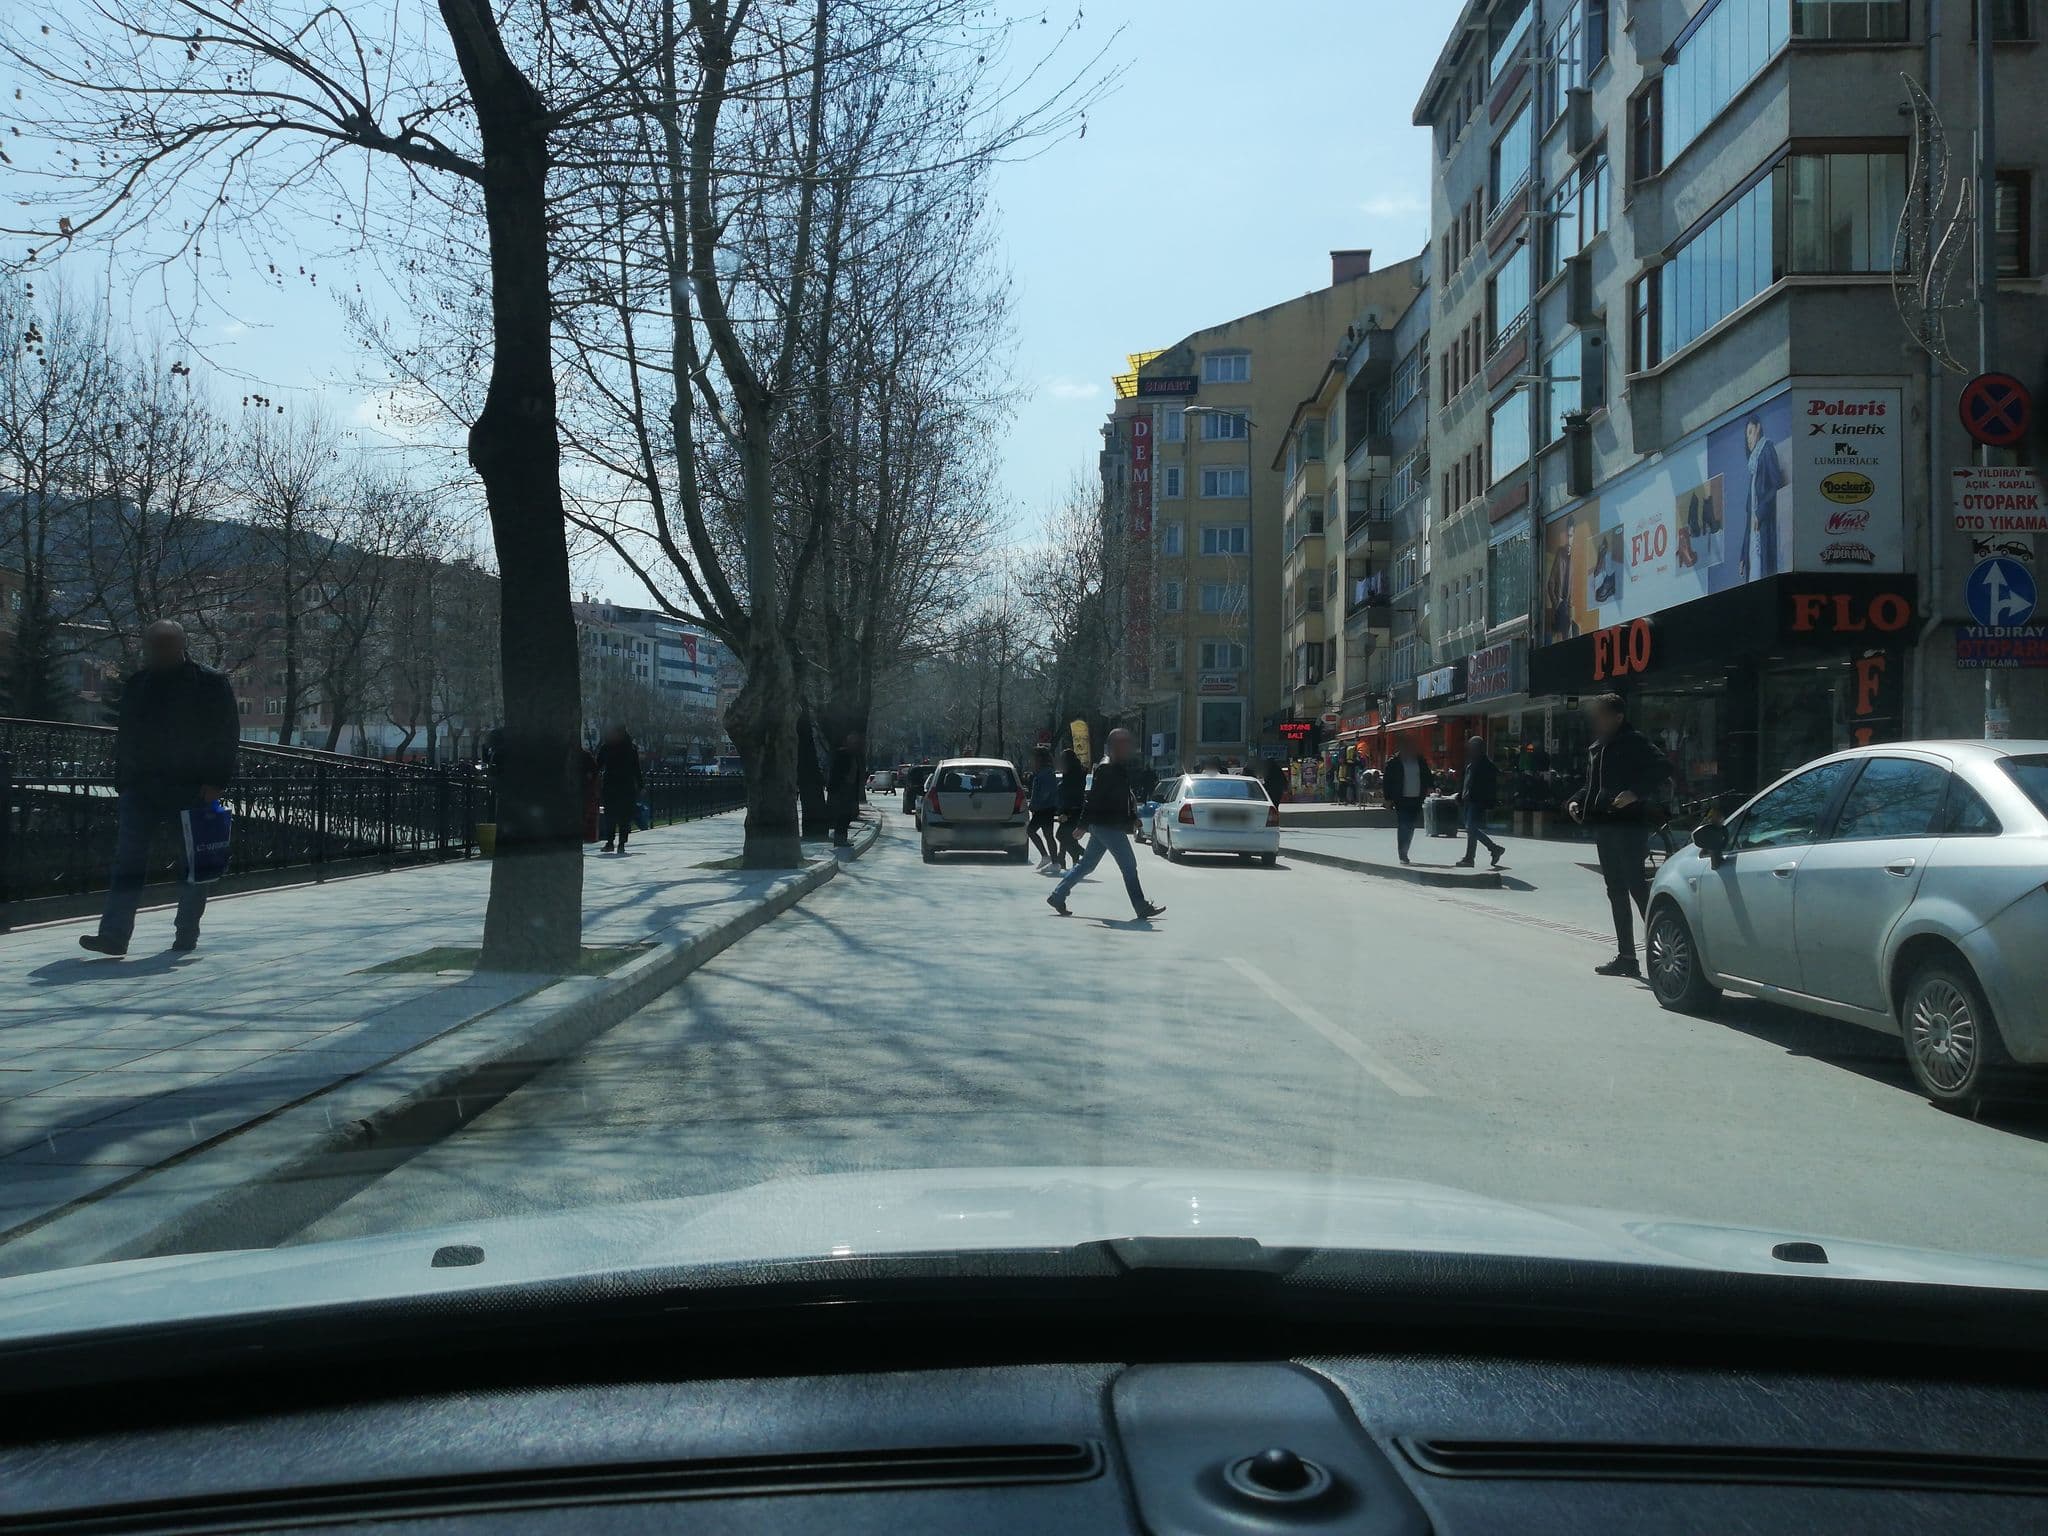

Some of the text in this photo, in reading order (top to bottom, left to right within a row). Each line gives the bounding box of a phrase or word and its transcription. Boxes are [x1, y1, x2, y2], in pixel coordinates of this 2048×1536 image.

[1807, 400, 1886, 416] Polaris
[1814, 457, 1879, 465] LUMBERJACK
[1965, 481, 1990, 490] AÇIK
[1998, 481, 2035, 489] KAPALI
[1963, 494, 2039, 510] OTOPARK
[1956, 515, 2048, 530] OTO YIKAMA
[1631, 523, 1668, 567] FLO
[1791, 594, 1911, 631] FLO
[1593, 617, 1651, 681] FLO
[1958, 658, 2019, 668] OTO YIKAMA
